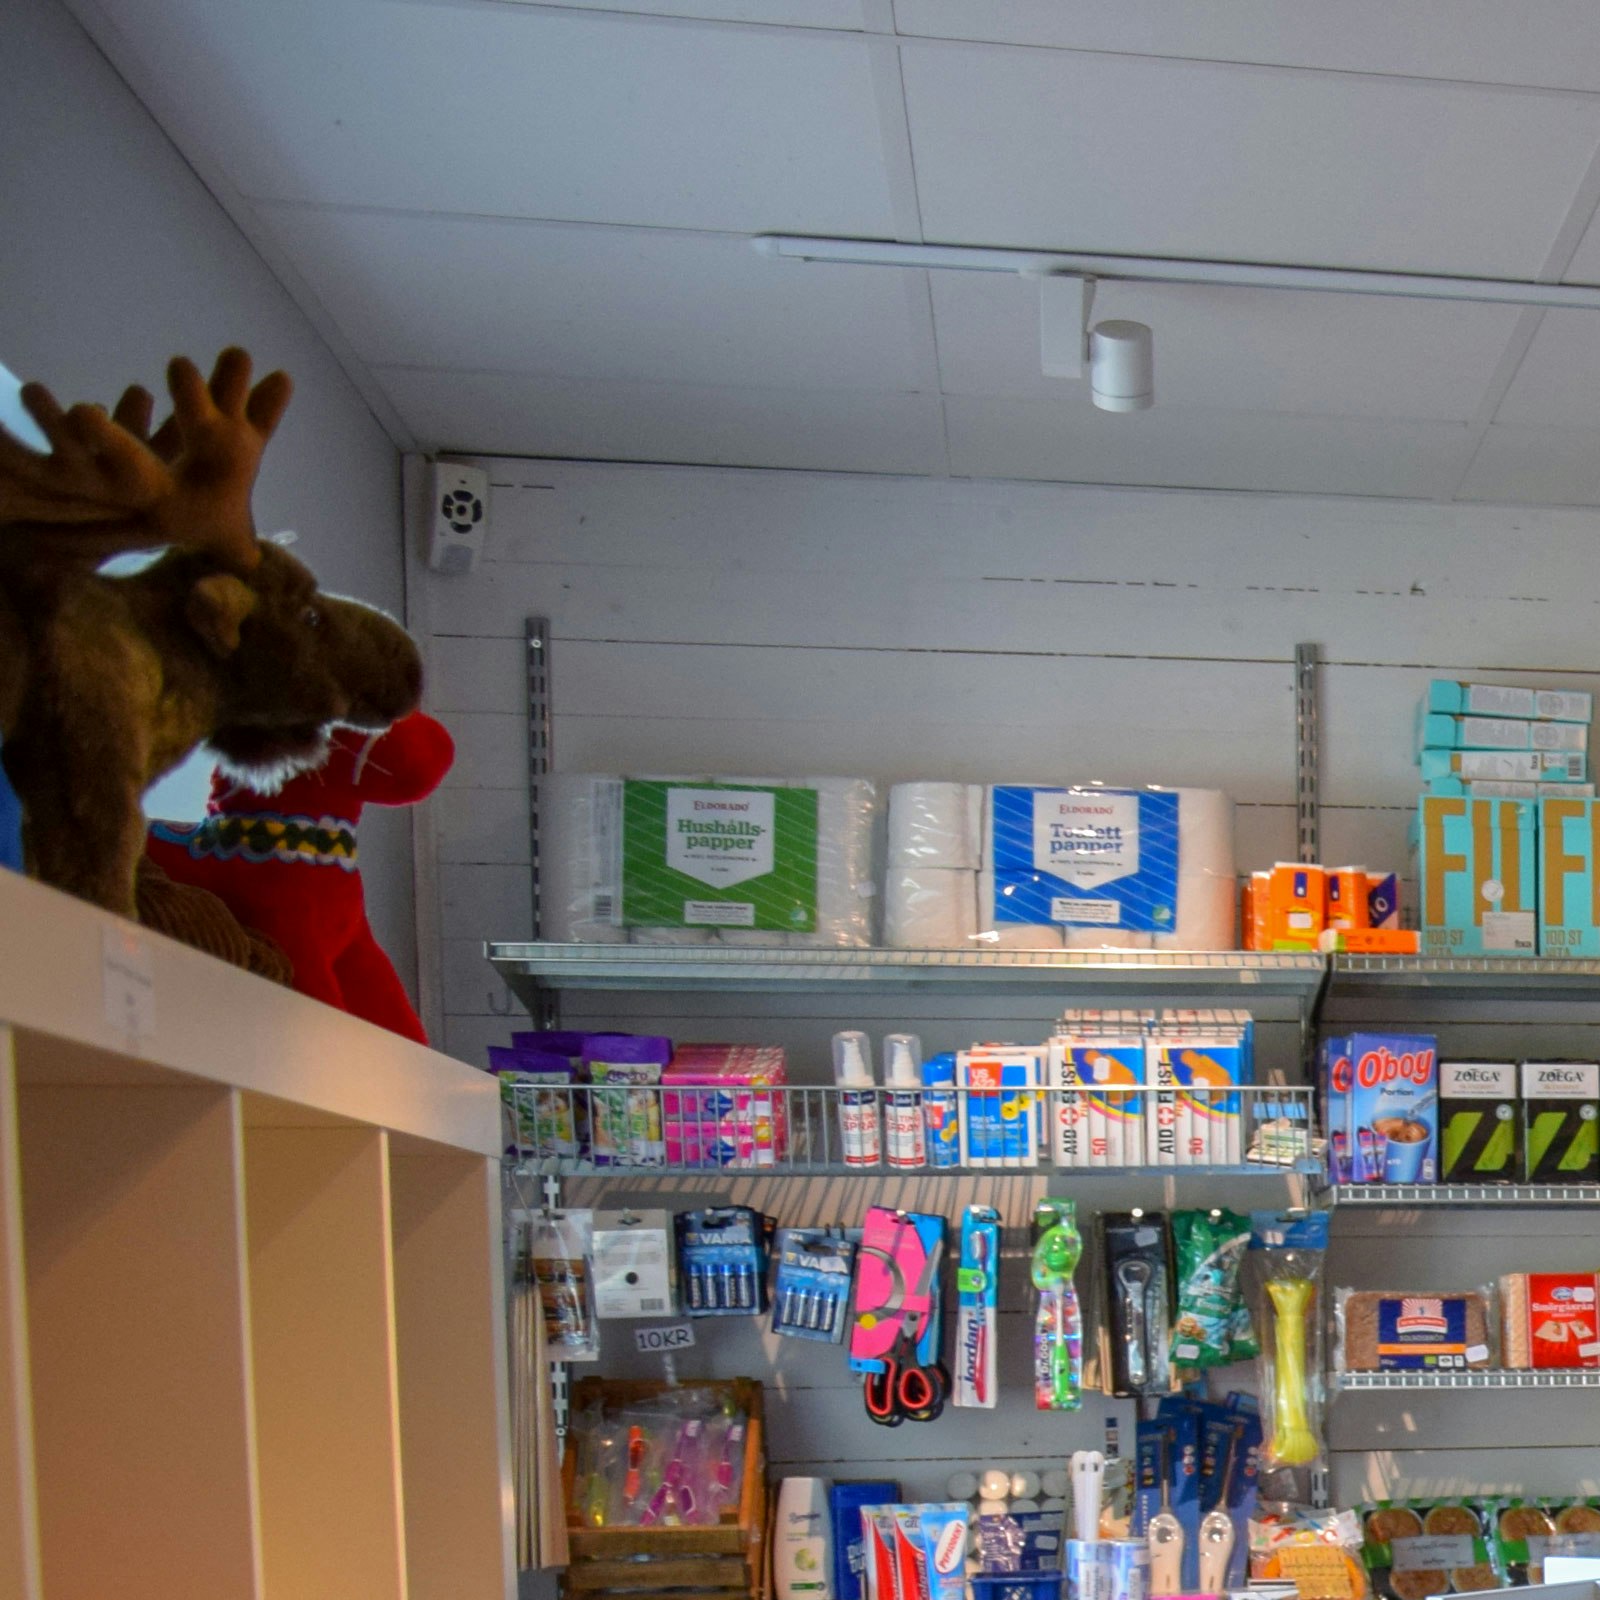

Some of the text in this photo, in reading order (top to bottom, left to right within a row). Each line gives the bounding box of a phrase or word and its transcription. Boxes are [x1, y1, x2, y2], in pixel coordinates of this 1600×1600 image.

[694, 801, 749, 811] ELDORADO
[1059, 804, 1113, 814] ELDORADO
[677, 819, 766, 836] Hushålls-
[1050, 823, 1122, 840] Toalett
[687, 835, 755, 850] papper
[971, 1068, 987, 1079] US
[1358, 1047, 1434, 1088] O'boy
[1380, 1088, 1414, 1097] Portion
[1063, 1129, 1078, 1155] AID
[1092, 1138, 1107, 1156] 50
[1159, 1129, 1174, 1154] AID
[638, 1330, 691, 1348] 10KR
